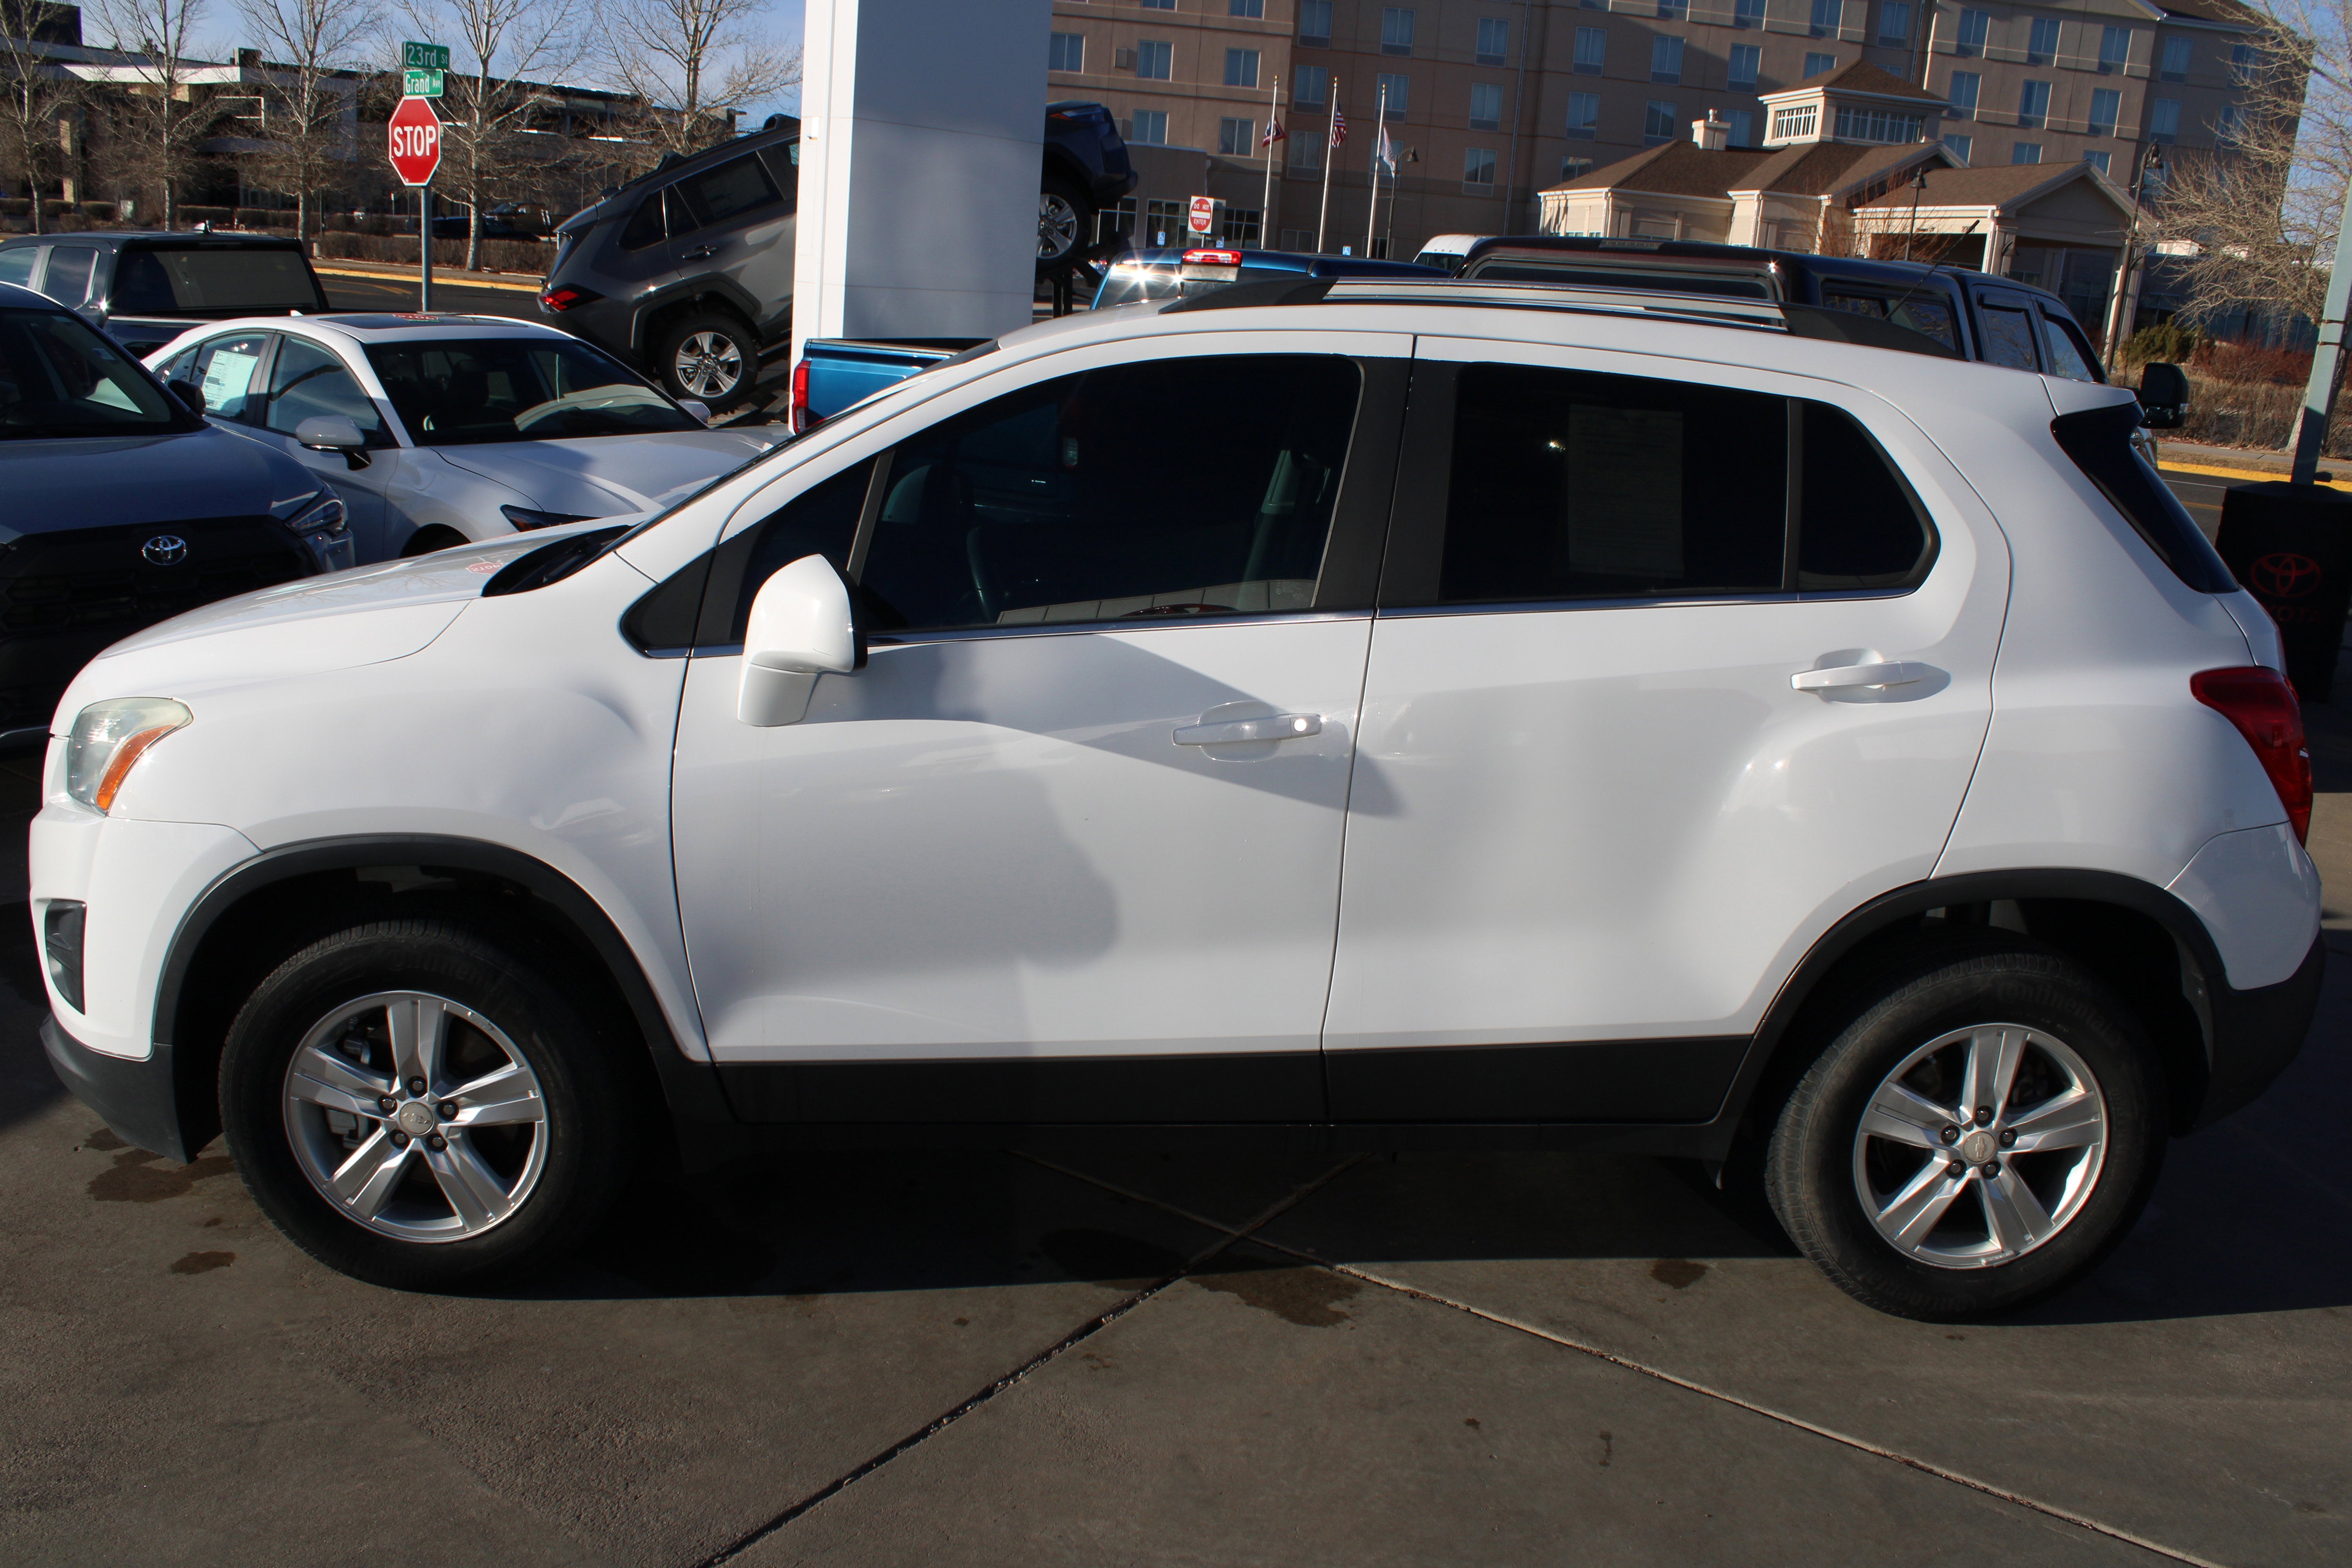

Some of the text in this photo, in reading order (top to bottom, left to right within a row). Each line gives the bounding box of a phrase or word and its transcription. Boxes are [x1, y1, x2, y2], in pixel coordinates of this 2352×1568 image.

[407, 44, 448, 67] 23rd St
[405, 74, 441, 94] Grand Ave
[393, 125, 437, 157] STOP
